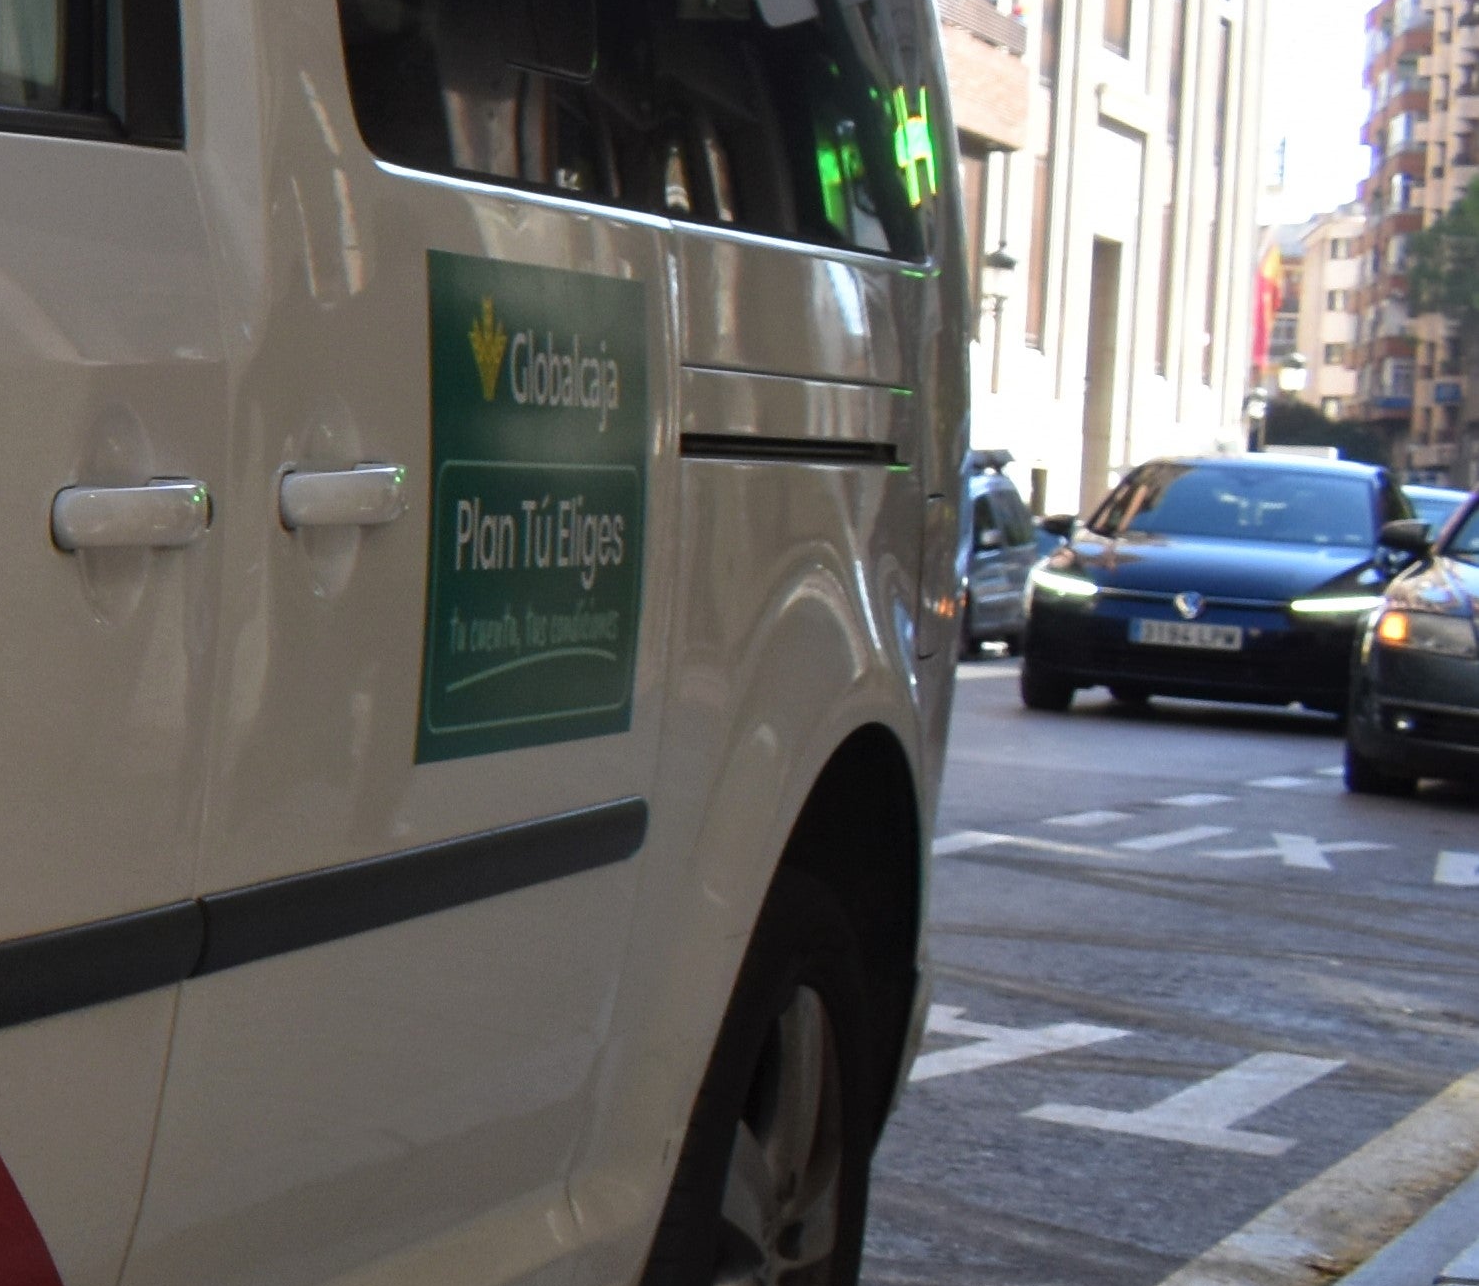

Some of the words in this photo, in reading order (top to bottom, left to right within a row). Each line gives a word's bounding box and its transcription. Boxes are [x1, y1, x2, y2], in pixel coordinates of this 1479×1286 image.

[509, 327, 620, 433] Globalcaja
[455, 496, 516, 571] Plan
[521, 494, 553, 569] Tú
[557, 495, 626, 591] Eliges
